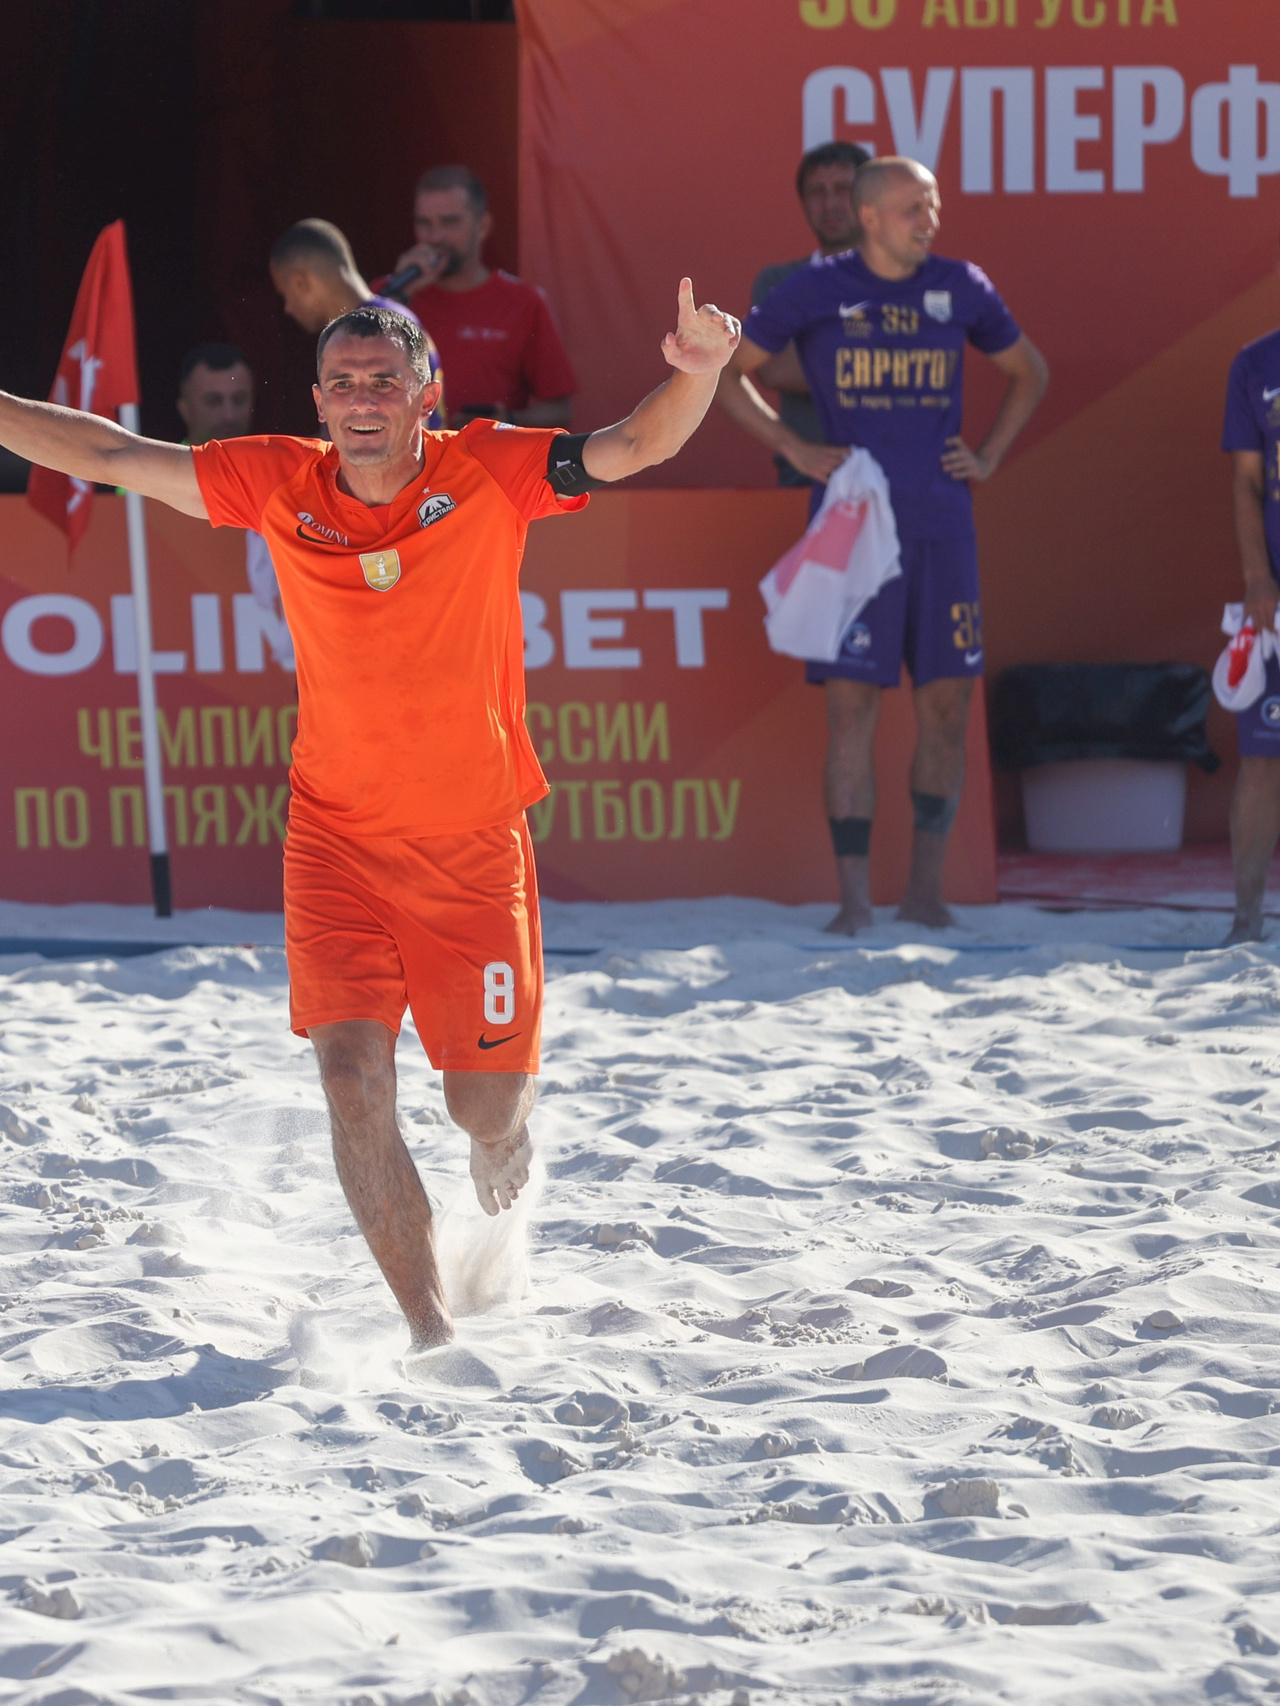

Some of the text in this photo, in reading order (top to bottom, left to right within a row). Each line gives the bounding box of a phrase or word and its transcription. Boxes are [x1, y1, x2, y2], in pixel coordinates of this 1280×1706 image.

[301, 513, 348, 546] DOMINA
[15, 786, 89, 849] ПО
[533, 778, 741, 842] УТБОЛУ
[483, 961, 515, 1025] 8
